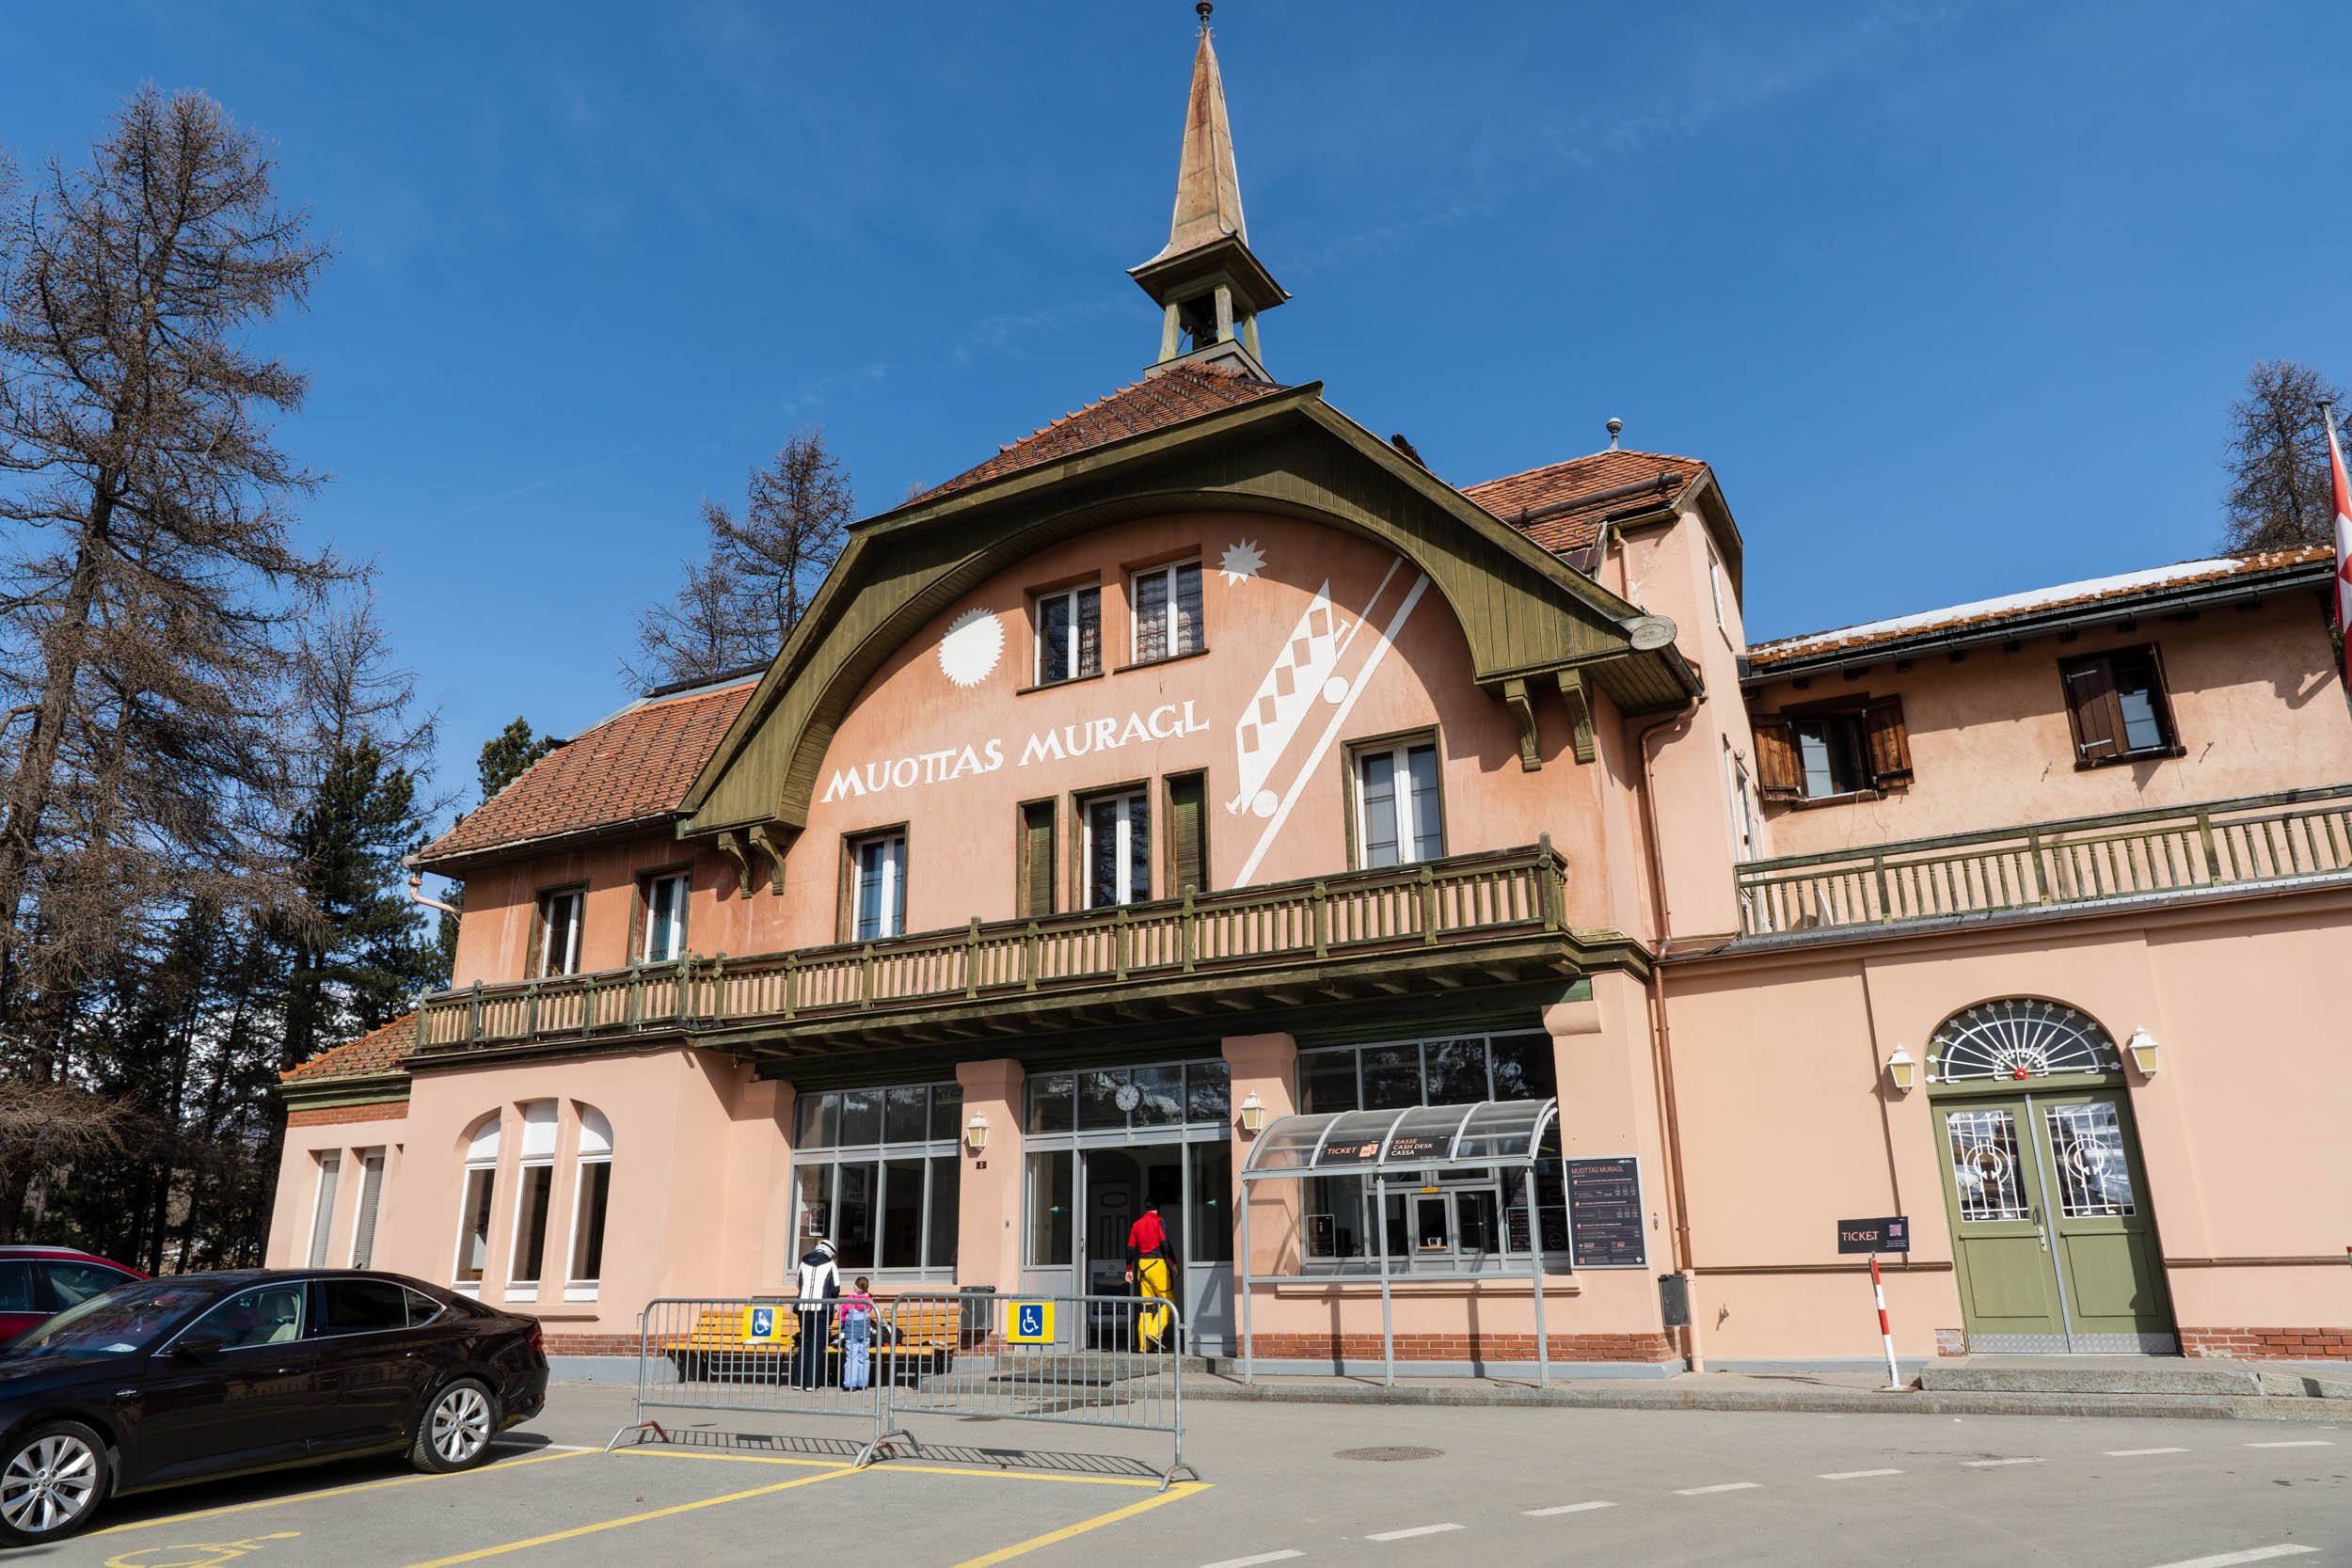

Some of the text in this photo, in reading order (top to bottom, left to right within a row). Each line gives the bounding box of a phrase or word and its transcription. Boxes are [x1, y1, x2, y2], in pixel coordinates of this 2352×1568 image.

[820, 700, 1210, 803] MUOTTAS MURAGL
[1327, 1147, 1358, 1155] TICKET
[1571, 1166, 1599, 1175] MUOTTAS
[1841, 1230, 1880, 1242] TICKET
